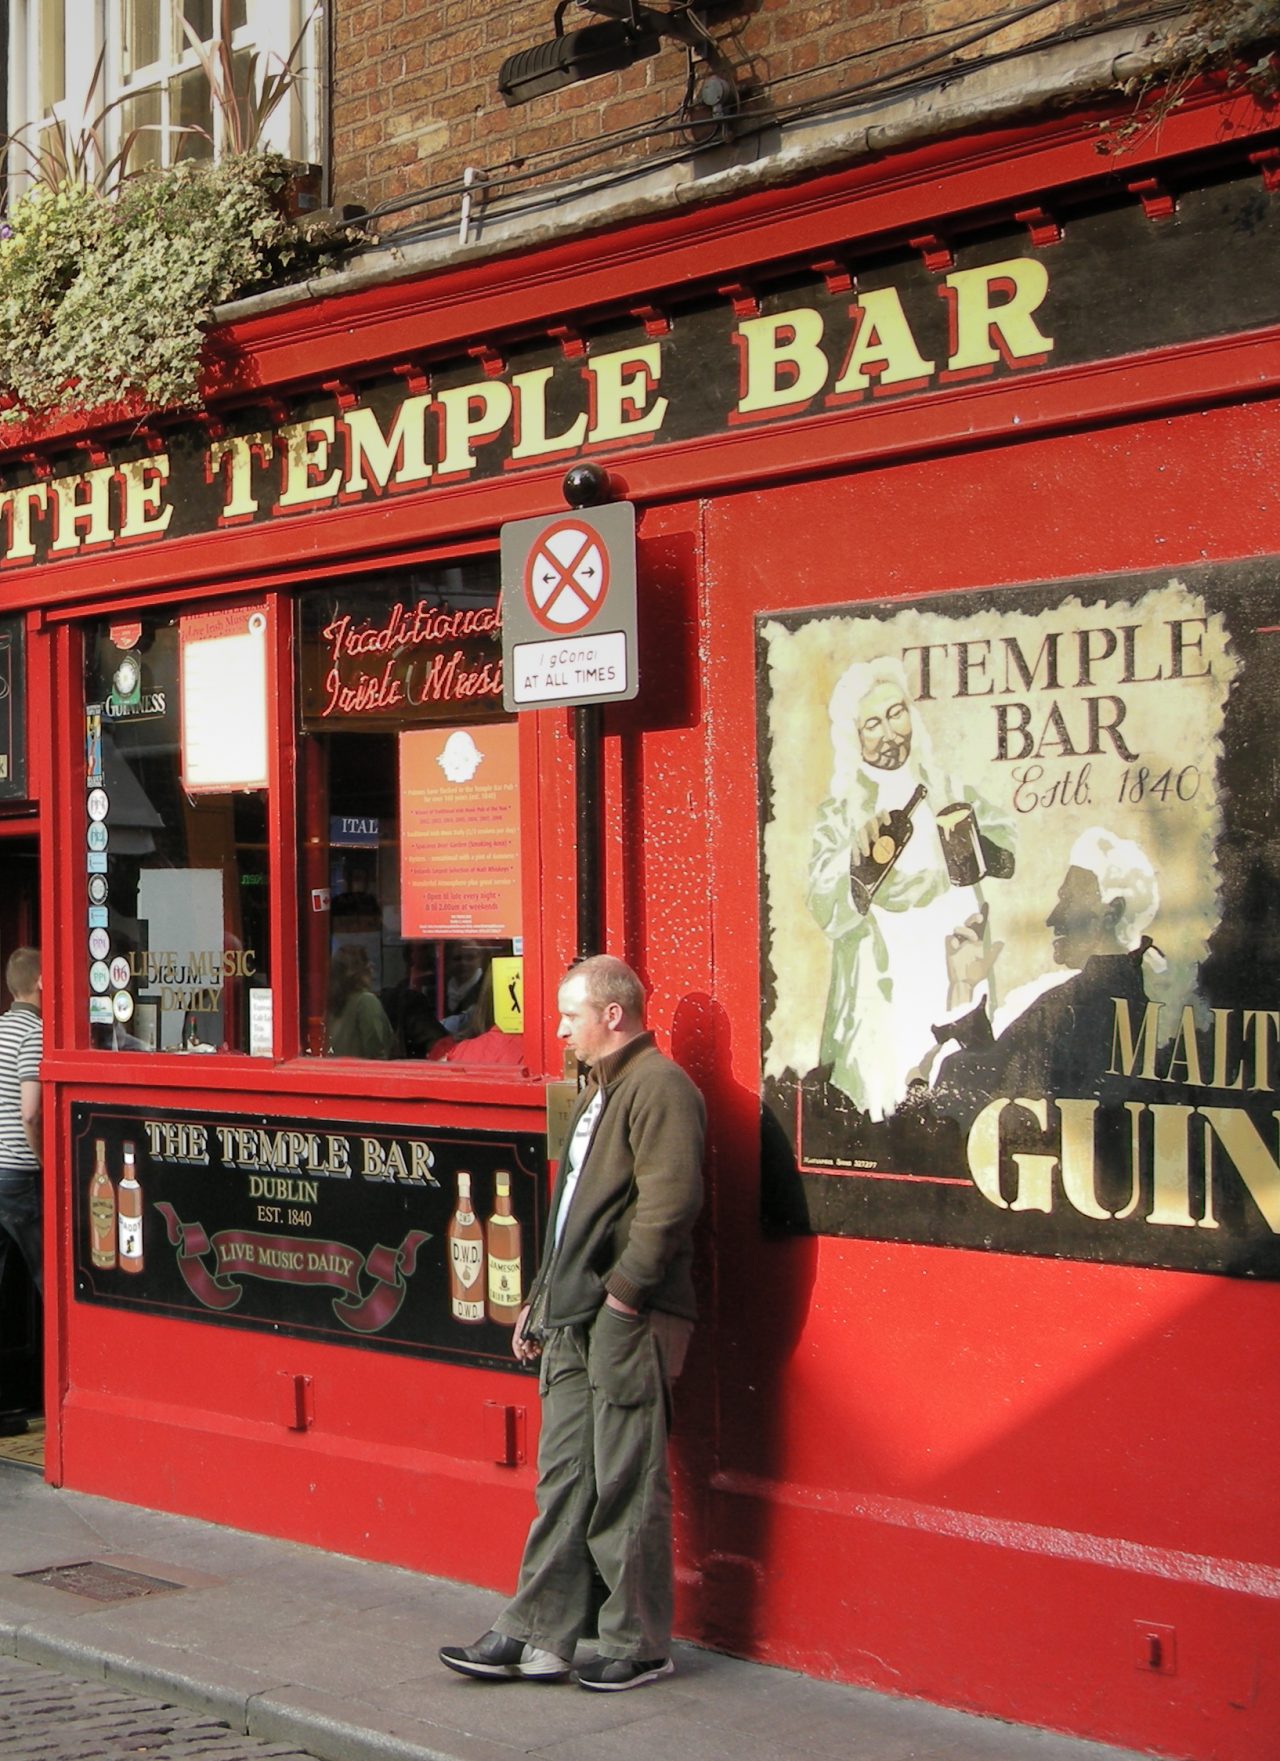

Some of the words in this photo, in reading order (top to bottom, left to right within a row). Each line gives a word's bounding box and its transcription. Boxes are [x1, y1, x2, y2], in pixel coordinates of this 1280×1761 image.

[206, 342, 670, 522] TEMPLE
[728, 256, 1055, 426] BAR
[322, 592, 504, 660] Traditional
[524, 675, 539, 689] AT
[545, 672, 568, 687] ALL
[575, 666, 616, 684] TIMES
[902, 618, 1212, 702] TEMPLE
[322, 660, 405, 717] Irish
[991, 695, 1140, 763] BAR
[1118, 764, 1201, 804] 1840
[342, 819, 379, 834] ITAL
[129, 951, 178, 977] LIVE
[187, 949, 257, 978] MUSIC
[160, 985, 222, 1012] DAILY
[1105, 996, 1280, 1092] MALT
[145, 1121, 210, 1165] THE
[216, 1127, 352, 1179] TEMPLE
[360, 1137, 440, 1187] BAR
[967, 1097, 1280, 1234] GUIN
[249, 1175, 318, 1204] DUBLIN
[257, 1205, 283, 1224] EST.
[287, 1208, 312, 1227] 1840
[220, 1243, 254, 1262] LIVE
[258, 1248, 304, 1271] MUSIC
[308, 1253, 354, 1277] DAILY
[489, 1261, 520, 1273] JAMESON
